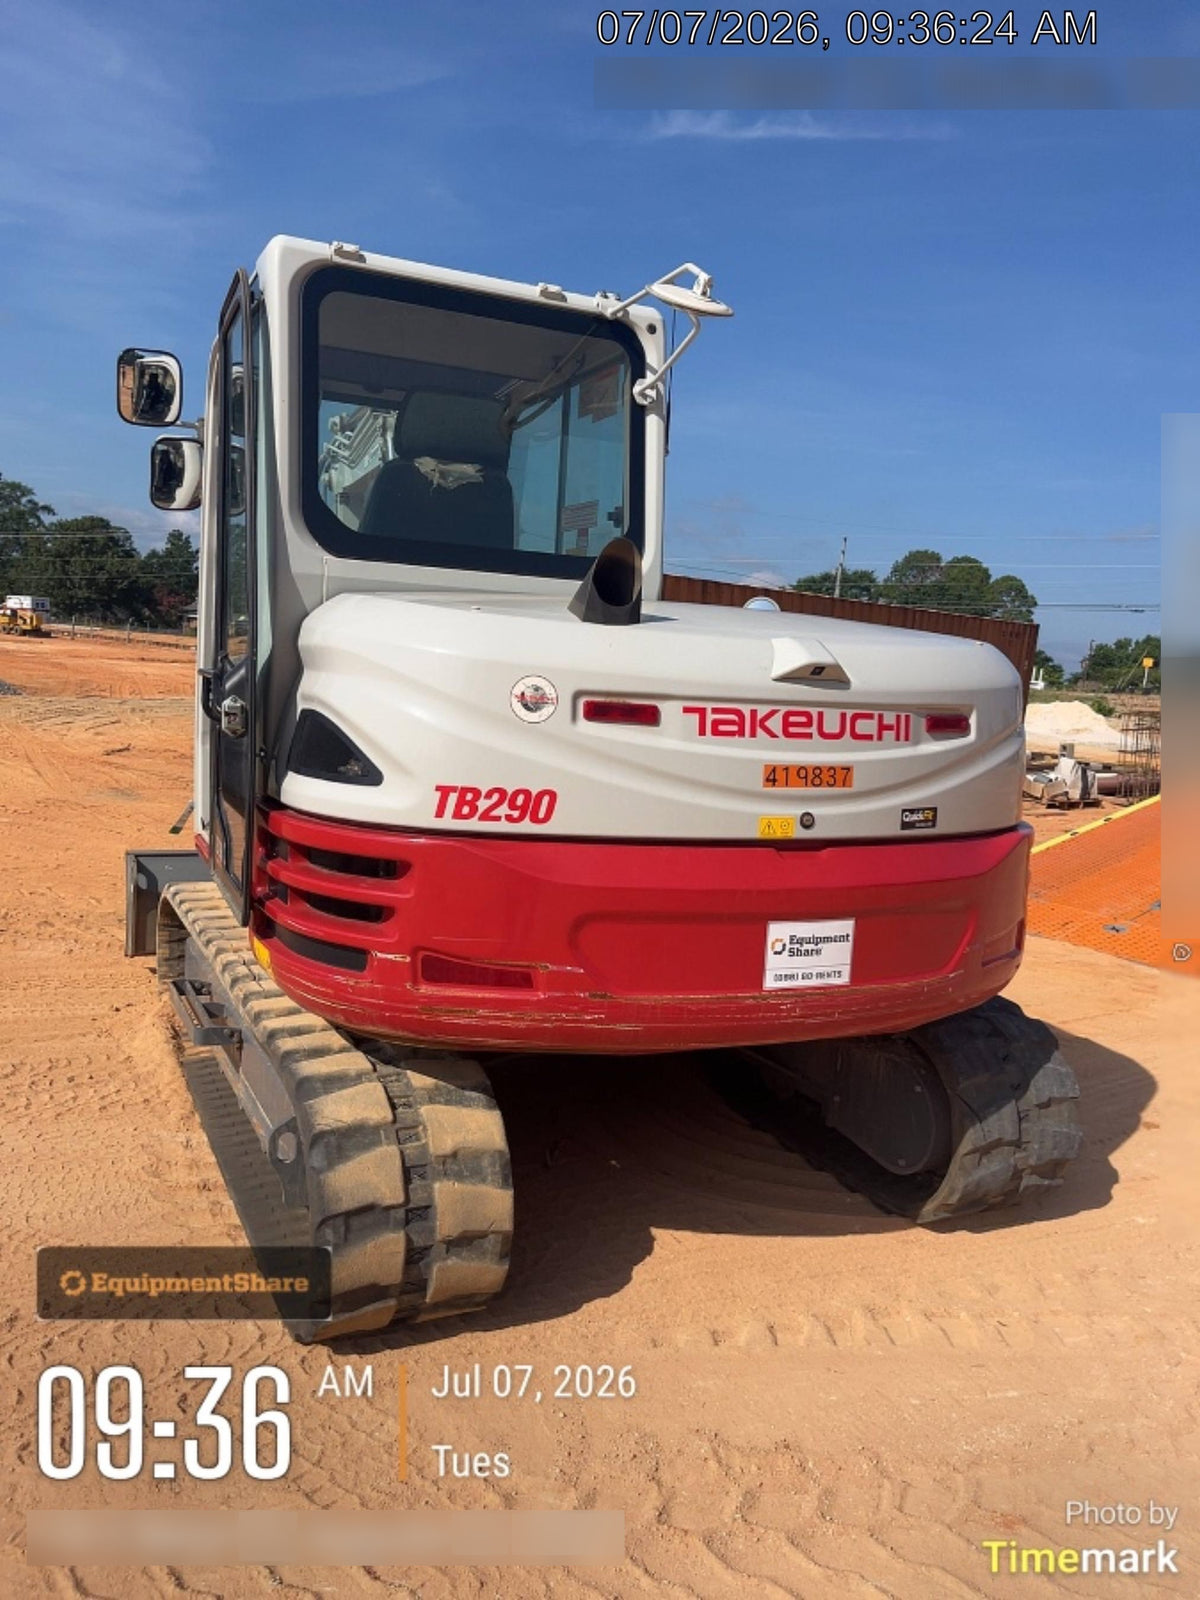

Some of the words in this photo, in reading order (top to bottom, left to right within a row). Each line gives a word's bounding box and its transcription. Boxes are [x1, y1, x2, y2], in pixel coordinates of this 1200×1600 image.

[683, 706, 911, 742] TAKEUCHI
[765, 766, 851, 788] 419837
[434, 785, 558, 824] TB290
[788, 933, 850, 947] Equipment
[788, 947, 823, 957] Share
